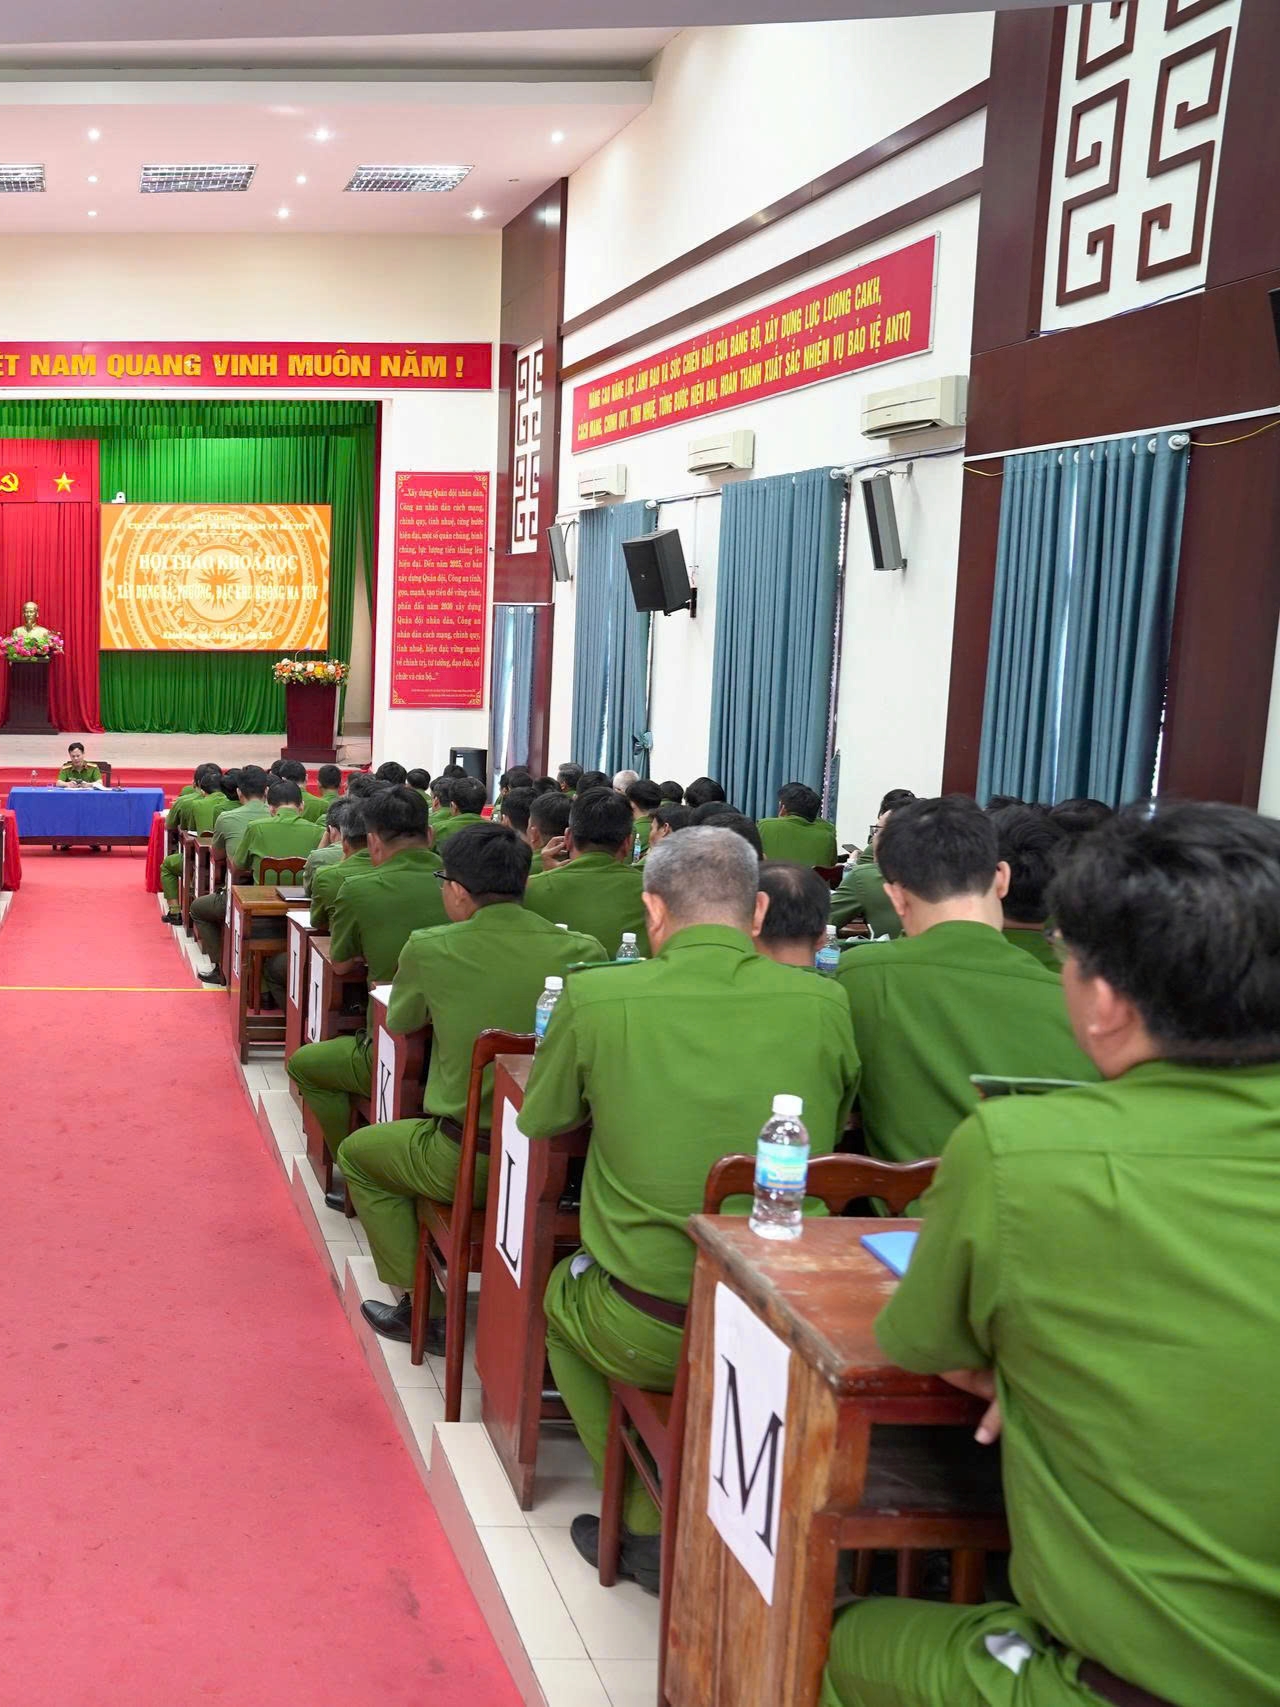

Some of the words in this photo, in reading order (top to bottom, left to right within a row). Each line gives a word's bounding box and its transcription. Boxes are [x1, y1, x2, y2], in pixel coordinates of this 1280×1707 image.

[764, 314, 779, 344] XÂY
[781, 308, 802, 341] DỰNG
[805, 300, 820, 333] LỰC
[823, 288, 851, 324] LƯỢNG
[855, 276, 881, 311] CAKH,
[785, 338, 800, 376] SẮC
[803, 335, 830, 371] NHIỆM
[833, 333, 844, 365] VỤ
[848, 318, 866, 356] BẢO
[870, 314, 881, 353] VỆ
[885, 310, 910, 344] ANTQ
[31, 355, 96, 377] NAM
[106, 353, 202, 378] QUANG
[213, 354, 278, 377] VINH
[288, 349, 370, 377] MUÔN
[381, 349, 447, 378] NĂM
[310, 980, 319, 1041] J
[378, 1060, 391, 1123] K
[499, 1150, 520, 1272] L
[713, 1353, 783, 1557] M
